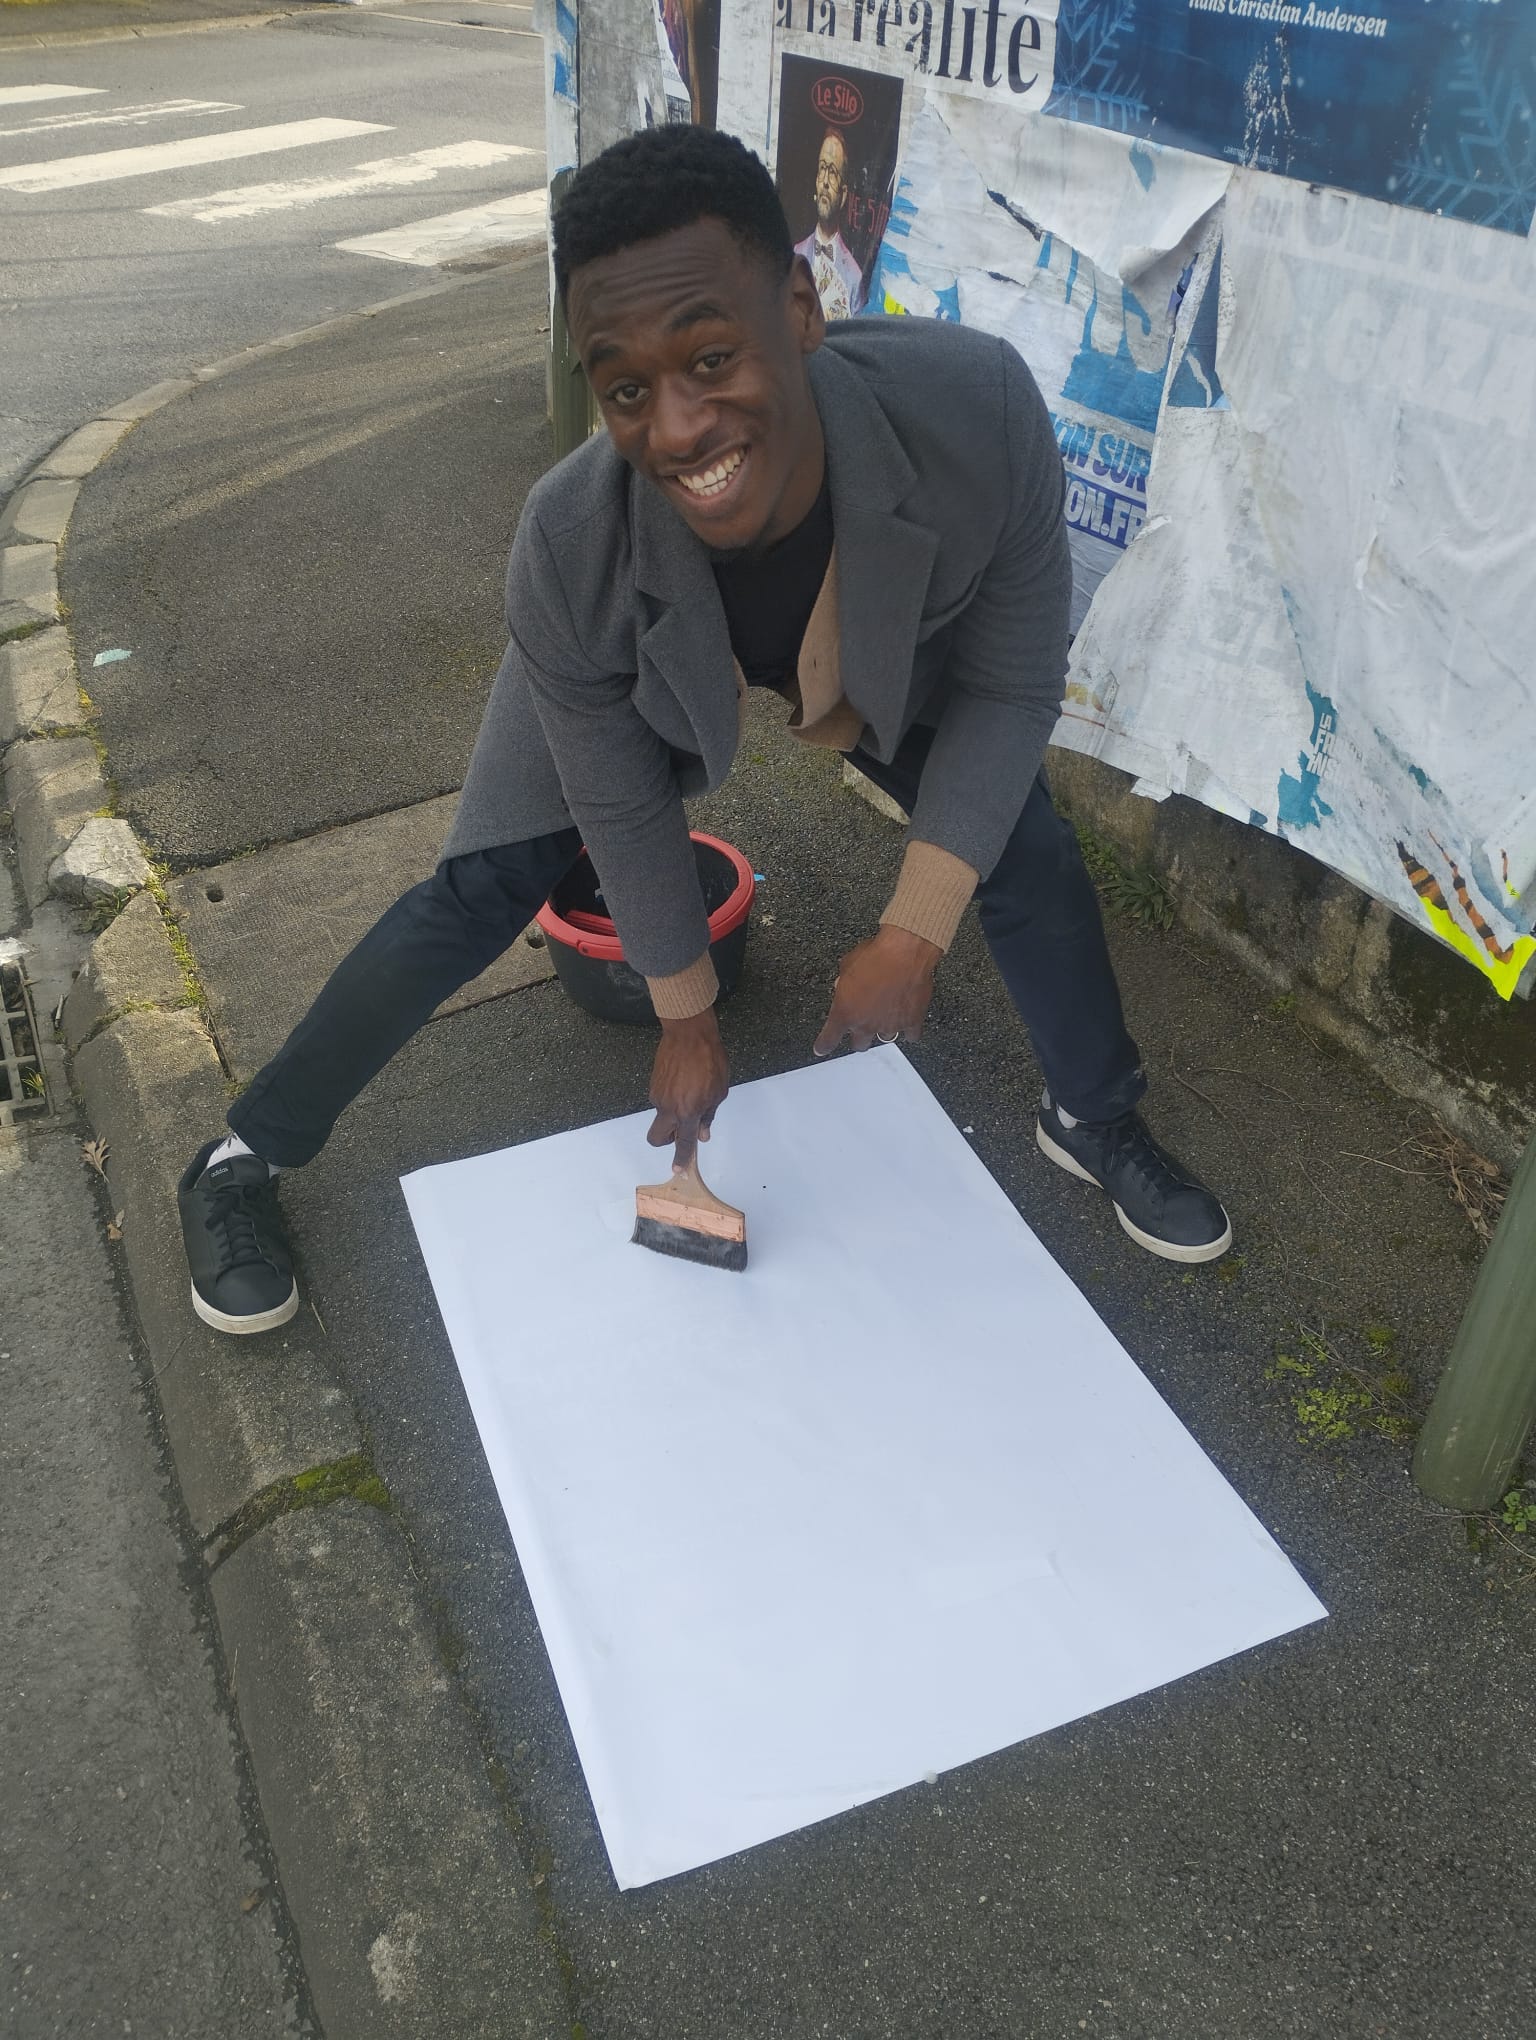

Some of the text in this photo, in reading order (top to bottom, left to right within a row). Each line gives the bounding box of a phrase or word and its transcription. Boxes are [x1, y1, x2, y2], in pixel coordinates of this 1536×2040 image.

[1229, 0, 1301, 25] Christian
[1302, 2, 1388, 37] Andersen
[817, 84, 831, 106] Le
[834, 84, 858, 114] Silo
[1092, 432, 1152, 494] SUR
[1063, 476, 1147, 544] ON.FR
